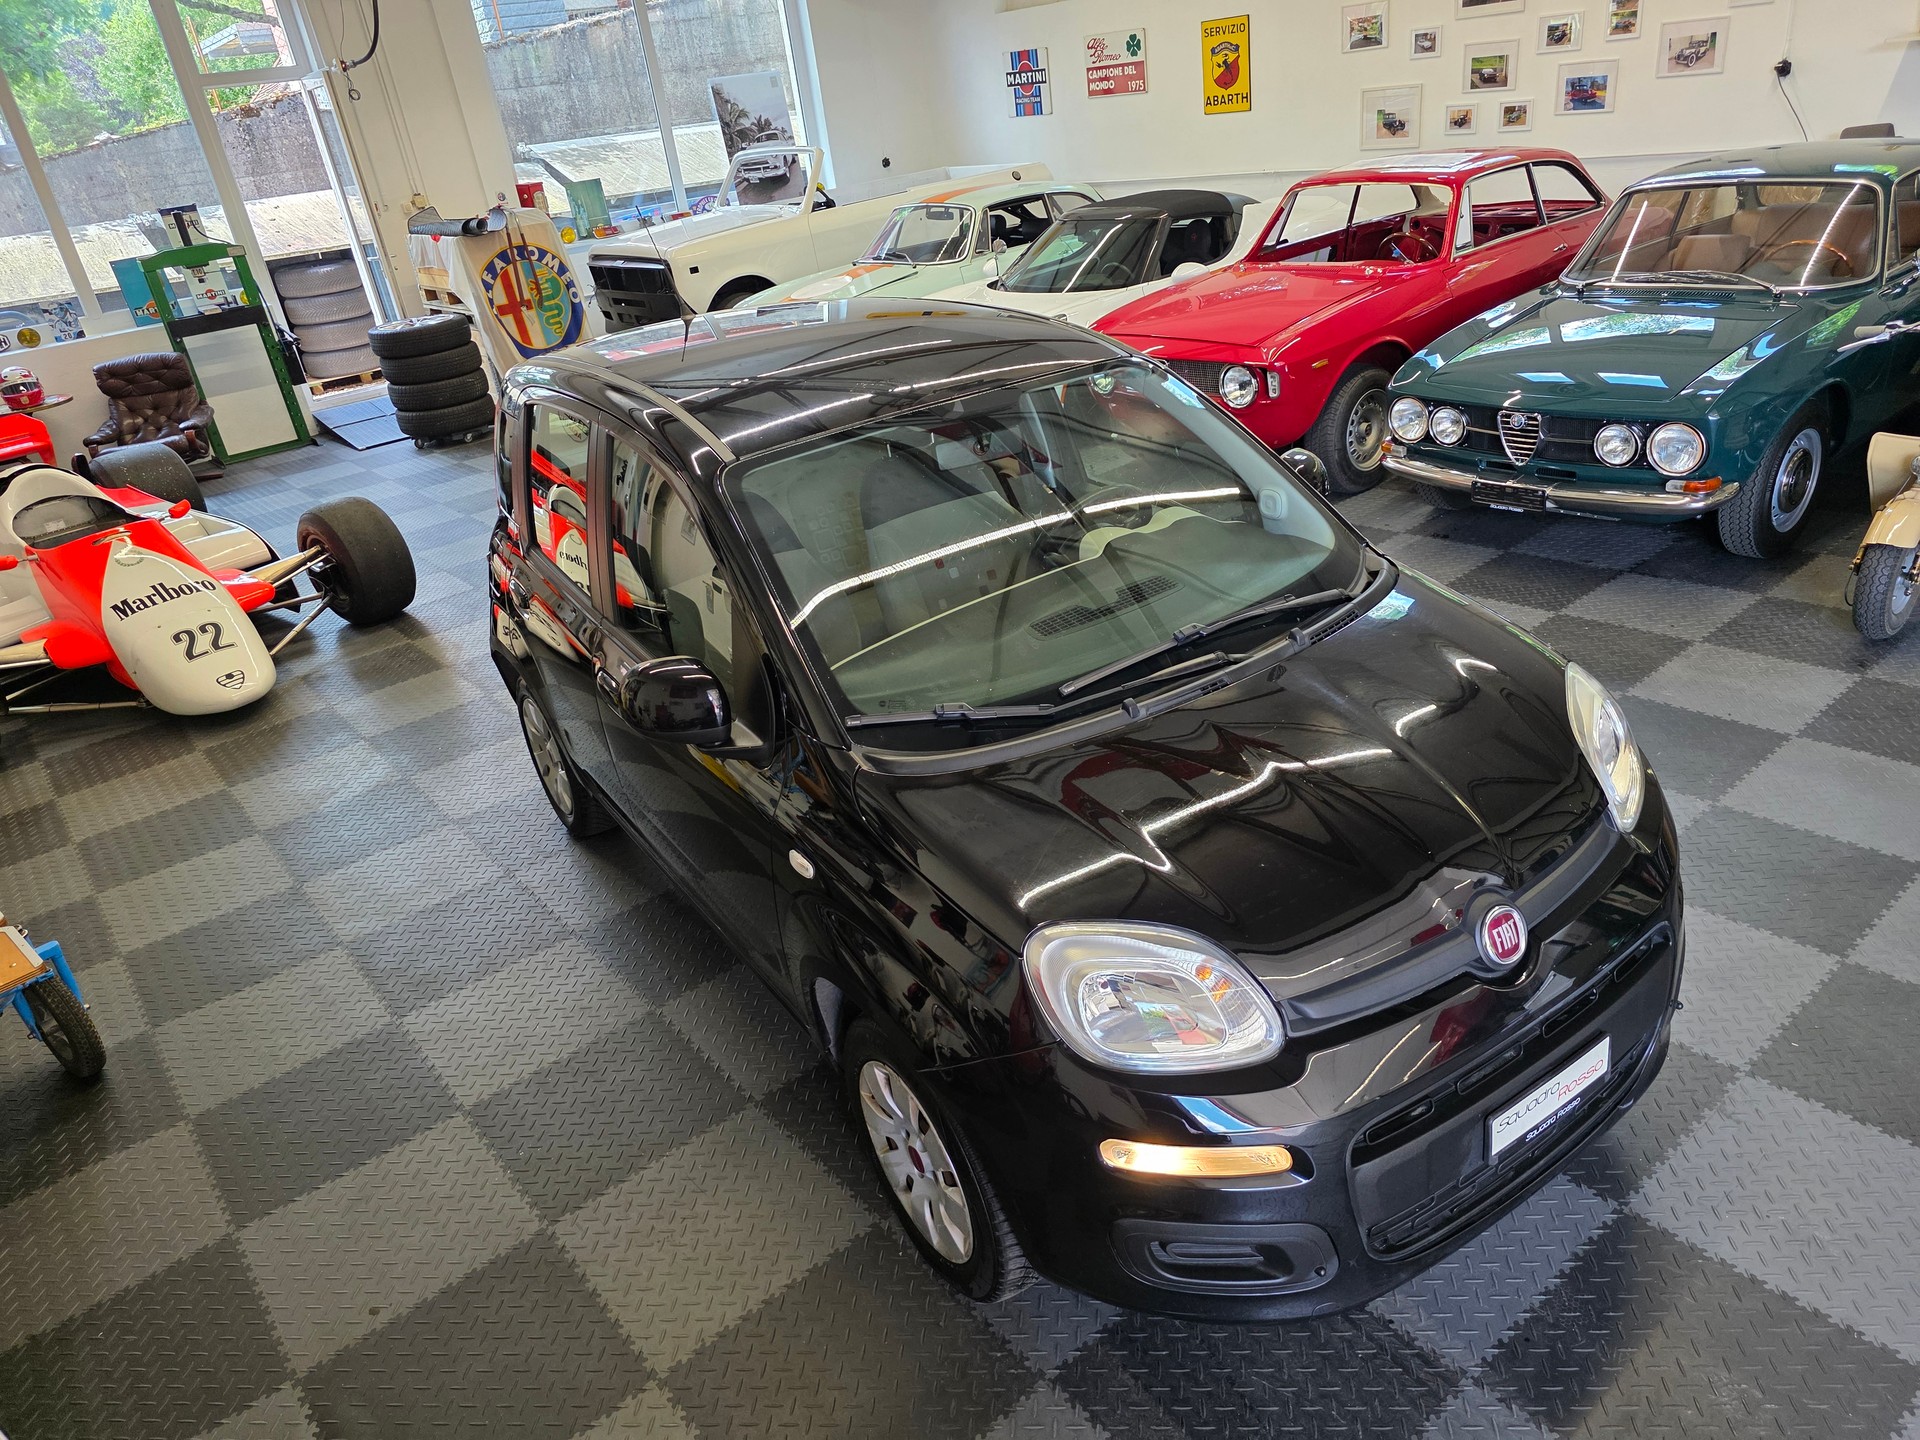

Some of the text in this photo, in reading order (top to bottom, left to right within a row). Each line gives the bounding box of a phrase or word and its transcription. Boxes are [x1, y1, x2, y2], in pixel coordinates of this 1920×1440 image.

[1203, 23, 1246, 38] SERVIZIO
[1087, 37, 1108, 51] Alfa
[1089, 49, 1121, 65] Romeo
[1006, 70, 1046, 86] MARTINI
[1088, 65, 1137, 80] CAMPIONE DEL
[1089, 80, 1145, 92] MONDO 1975
[1015, 95, 1041, 104] RACING TEAM
[1205, 92, 1249, 107] ABARTH
[197, 290, 227, 300] MARTINI
[110, 580, 217, 621] Marlboro
[171, 622, 237, 662] 22
[1492, 918, 1518, 954] FIAT
[1497, 1081, 1560, 1133] Squadra
[1525, 1115, 1557, 1142] Squadra
